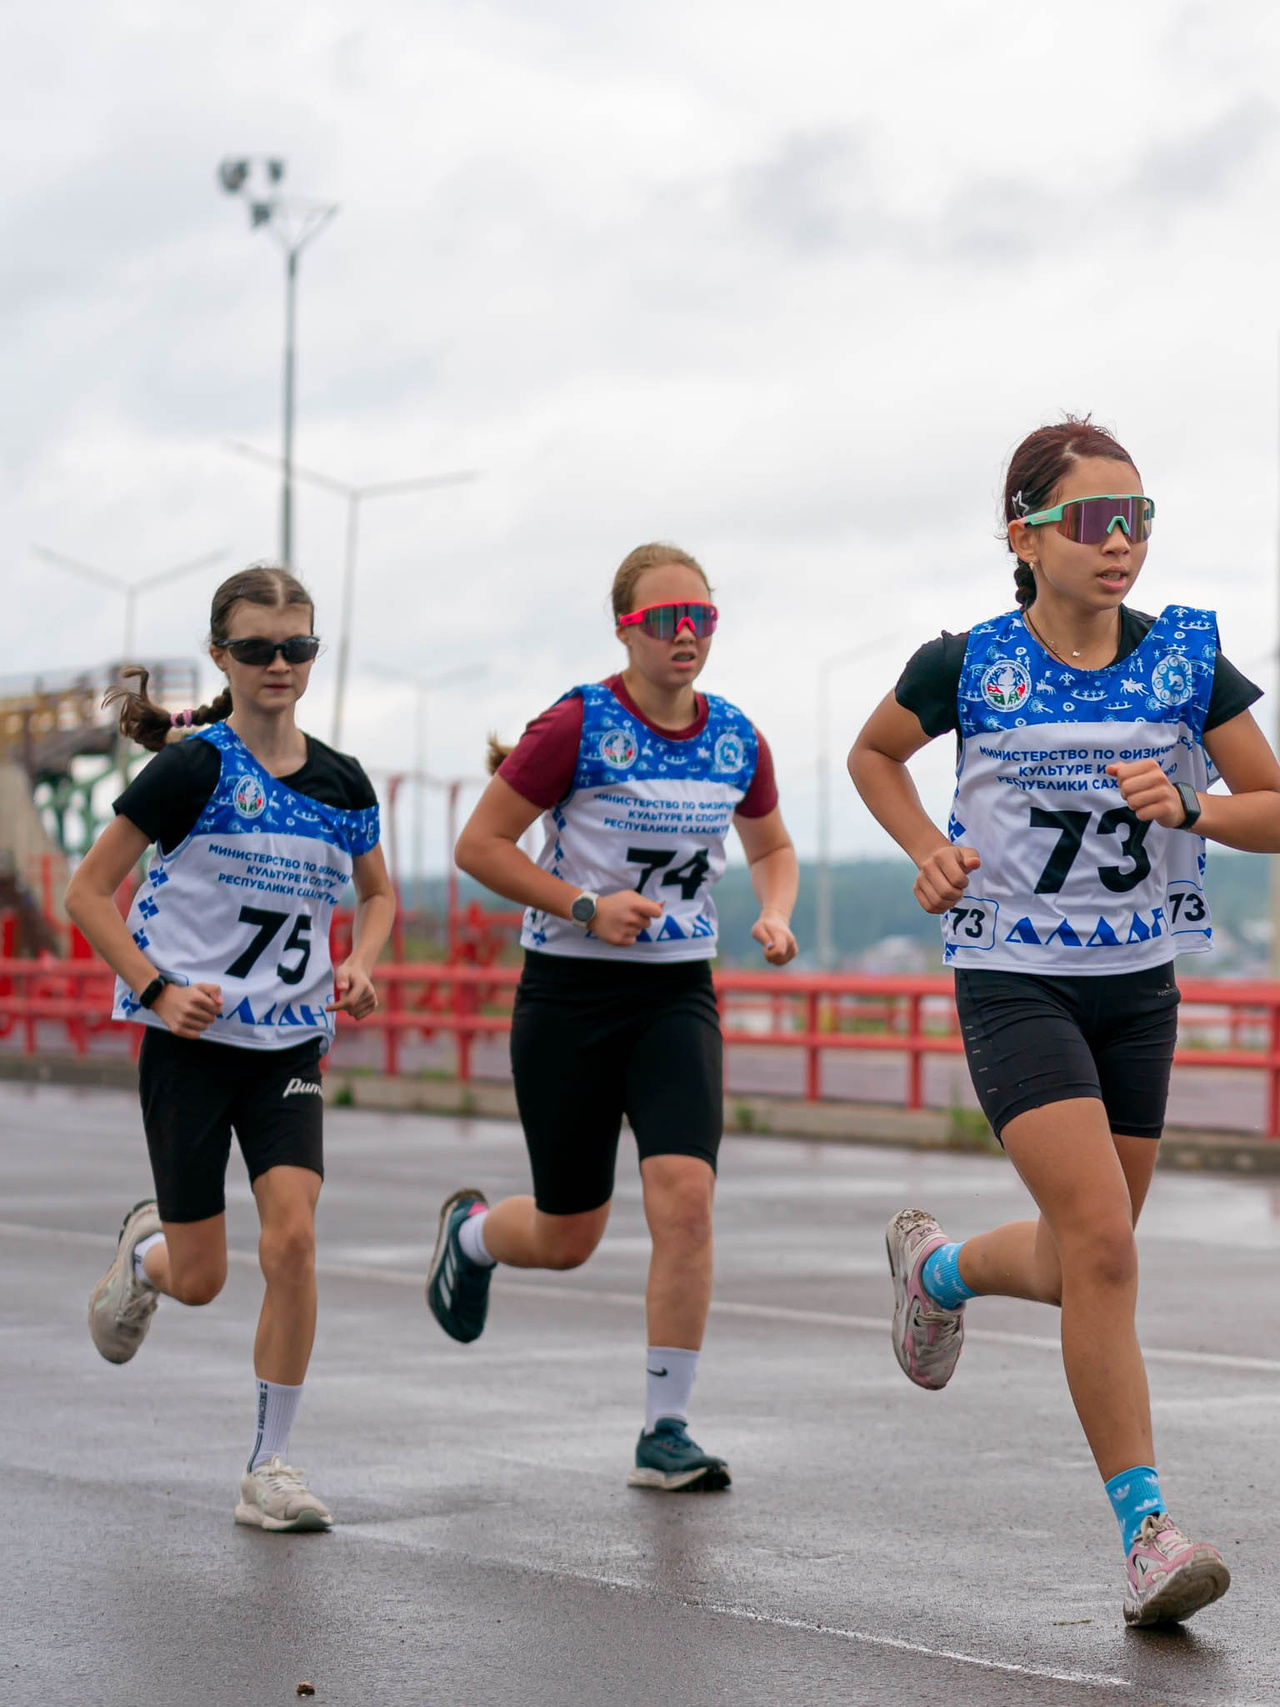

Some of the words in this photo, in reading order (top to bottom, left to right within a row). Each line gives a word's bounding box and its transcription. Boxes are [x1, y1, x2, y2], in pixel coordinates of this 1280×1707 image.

[979, 746, 1089, 762] МИНИСТЕРСТВО
[1093, 749, 1114, 760] ПО
[1019, 764, 1092, 777] КУЛЬТУРЕ
[593, 793, 679, 810] МИНИСТЕРСТВО
[682, 801, 695, 810] ПО
[604, 818, 678, 834] РЕСПУБЛИКИ
[628, 810, 682, 822] КУЛЬТУРЕ
[685, 814, 693, 822] И
[208, 843, 300, 870] МИНИСТЕРСТВО
[303, 861, 317, 872] ПО
[1029, 806, 1152, 894] 73
[218, 873, 294, 896] РЕСПУБЛИКИ
[247, 865, 300, 883] КУЛЬТУРЕ
[626, 847, 710, 900] 74
[1168, 893, 1206, 924] 73
[950, 907, 986, 938] 73
[224, 905, 313, 985] 75
